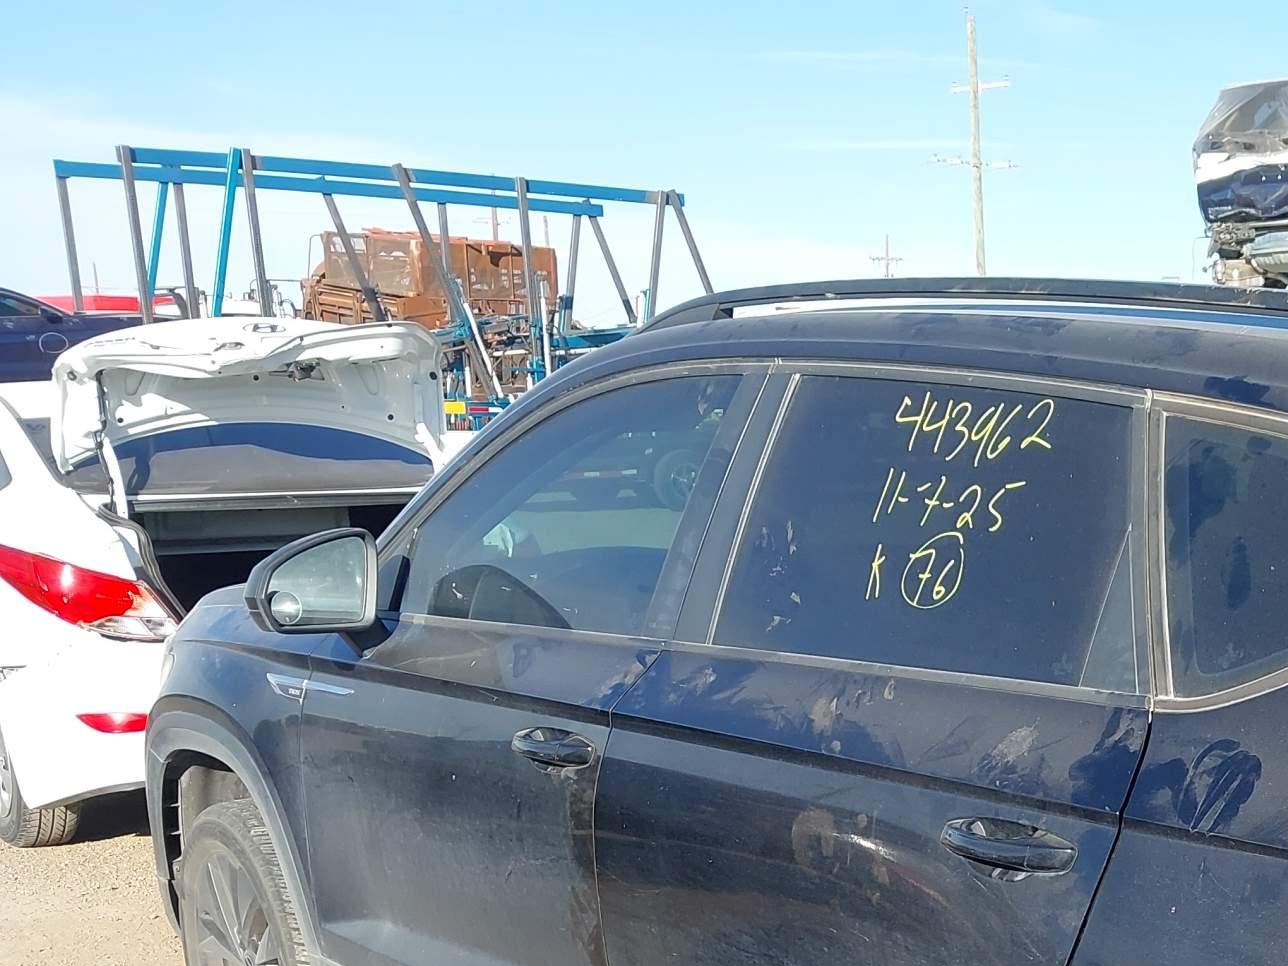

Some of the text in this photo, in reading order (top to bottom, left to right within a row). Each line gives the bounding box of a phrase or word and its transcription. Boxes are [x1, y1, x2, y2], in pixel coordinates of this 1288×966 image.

[896, 391, 1055, 467] 443962
[872, 467, 1027, 532] 11-7-25
[908, 546, 957, 605] 76
